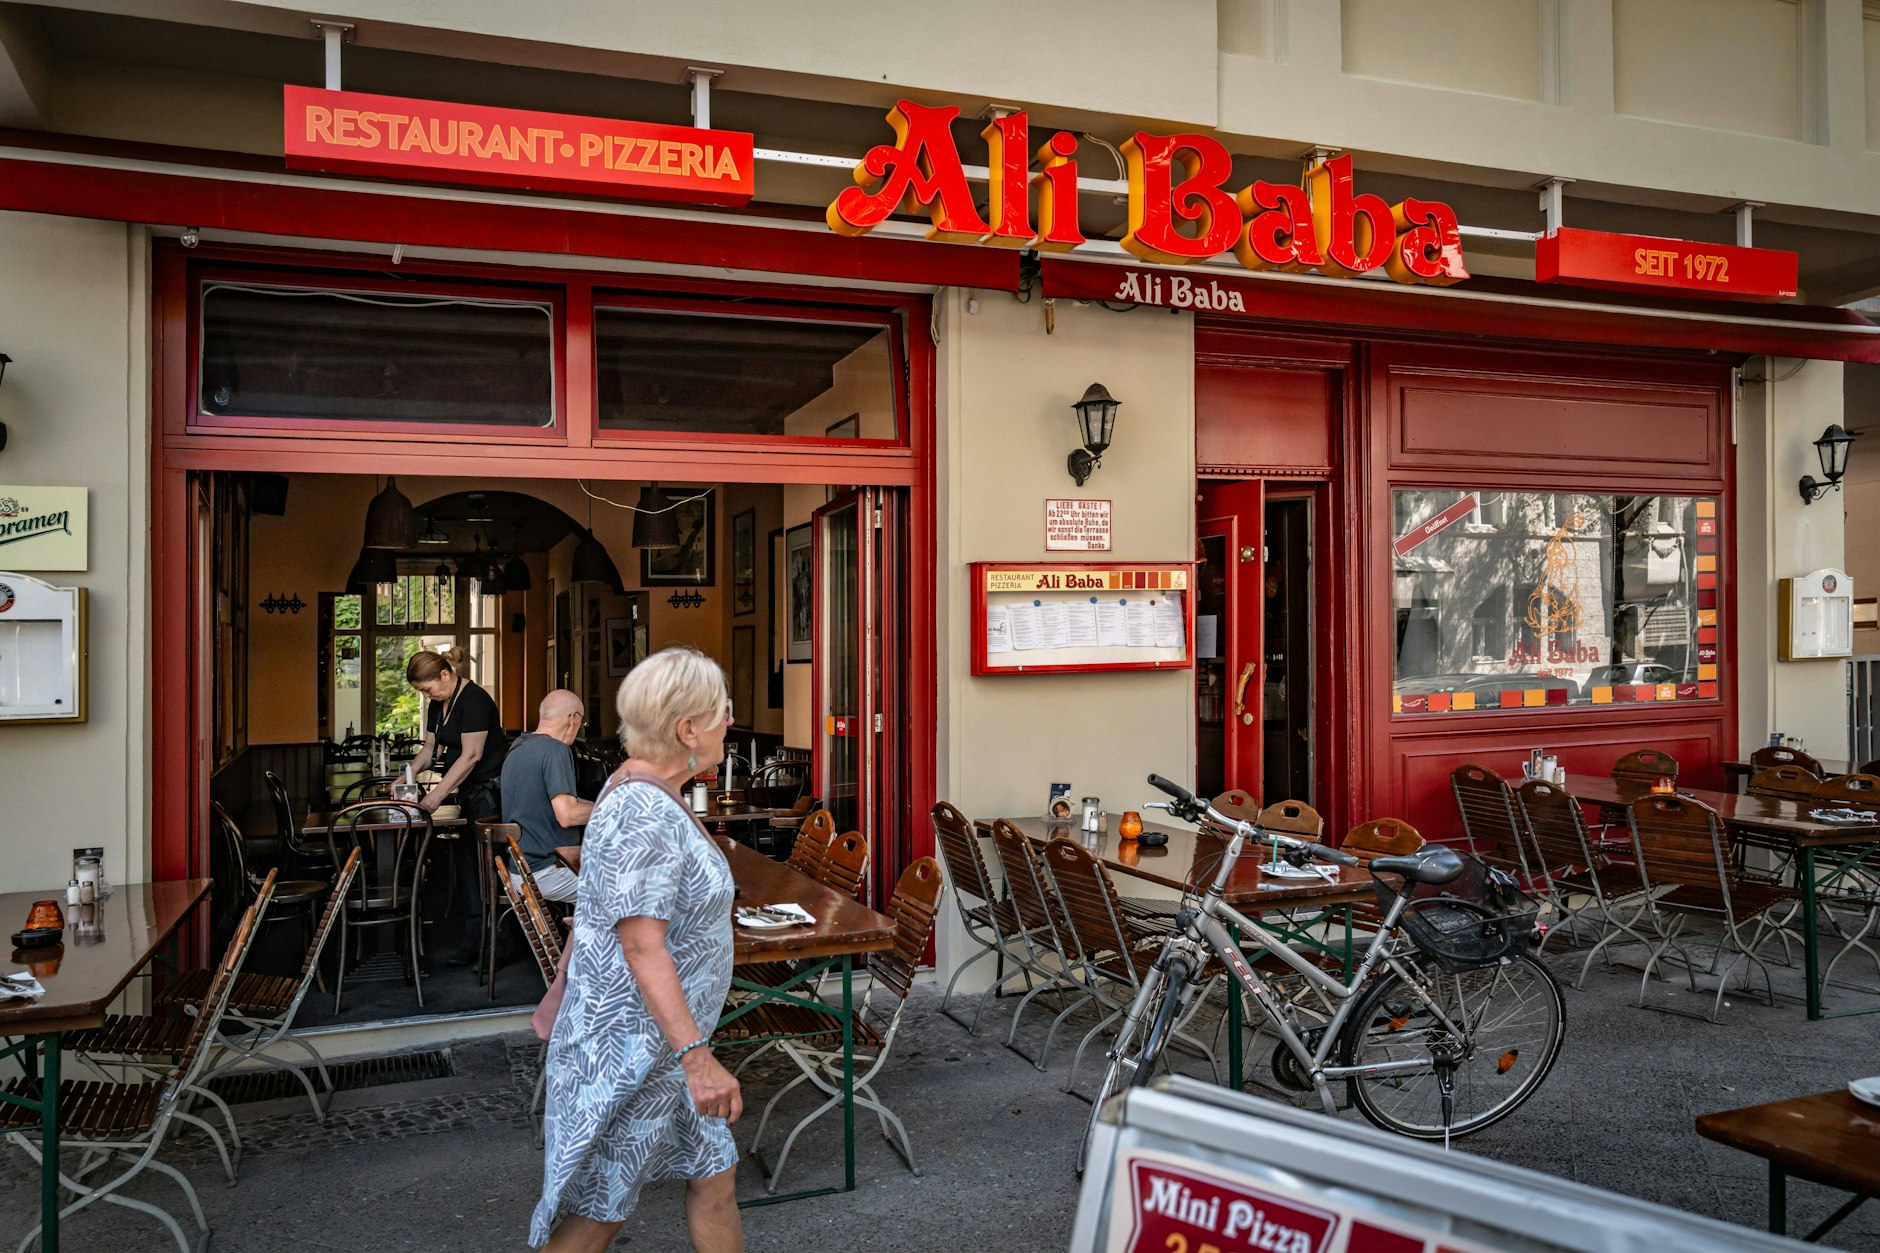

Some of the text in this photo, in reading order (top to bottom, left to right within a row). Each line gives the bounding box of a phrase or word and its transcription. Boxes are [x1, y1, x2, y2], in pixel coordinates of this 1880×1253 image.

[306, 105, 741, 181] RESTAURANT PIZZERIA
[827, 99, 1470, 285] Ali Baba
[1635, 248, 1729, 282] SEIT 1972
[1115, 271, 1246, 313] Ali Baba
[1059, 518, 1084, 526] absolute
[1424, 516, 1449, 534] Geöffnet
[1050, 533, 1078, 541] schließen
[1087, 541, 1105, 549] Danke
[990, 573, 1035, 581] RESTAURANT
[1036, 574, 1104, 589] Ali Baba
[1547, 639, 1600, 664] Baba
[1536, 668, 1574, 678] seit 1972
[1243, 922, 1272, 946] TOSCANA
[1223, 946, 1265, 997] FELT
[1143, 1175, 1312, 1253] Mini Pizza
